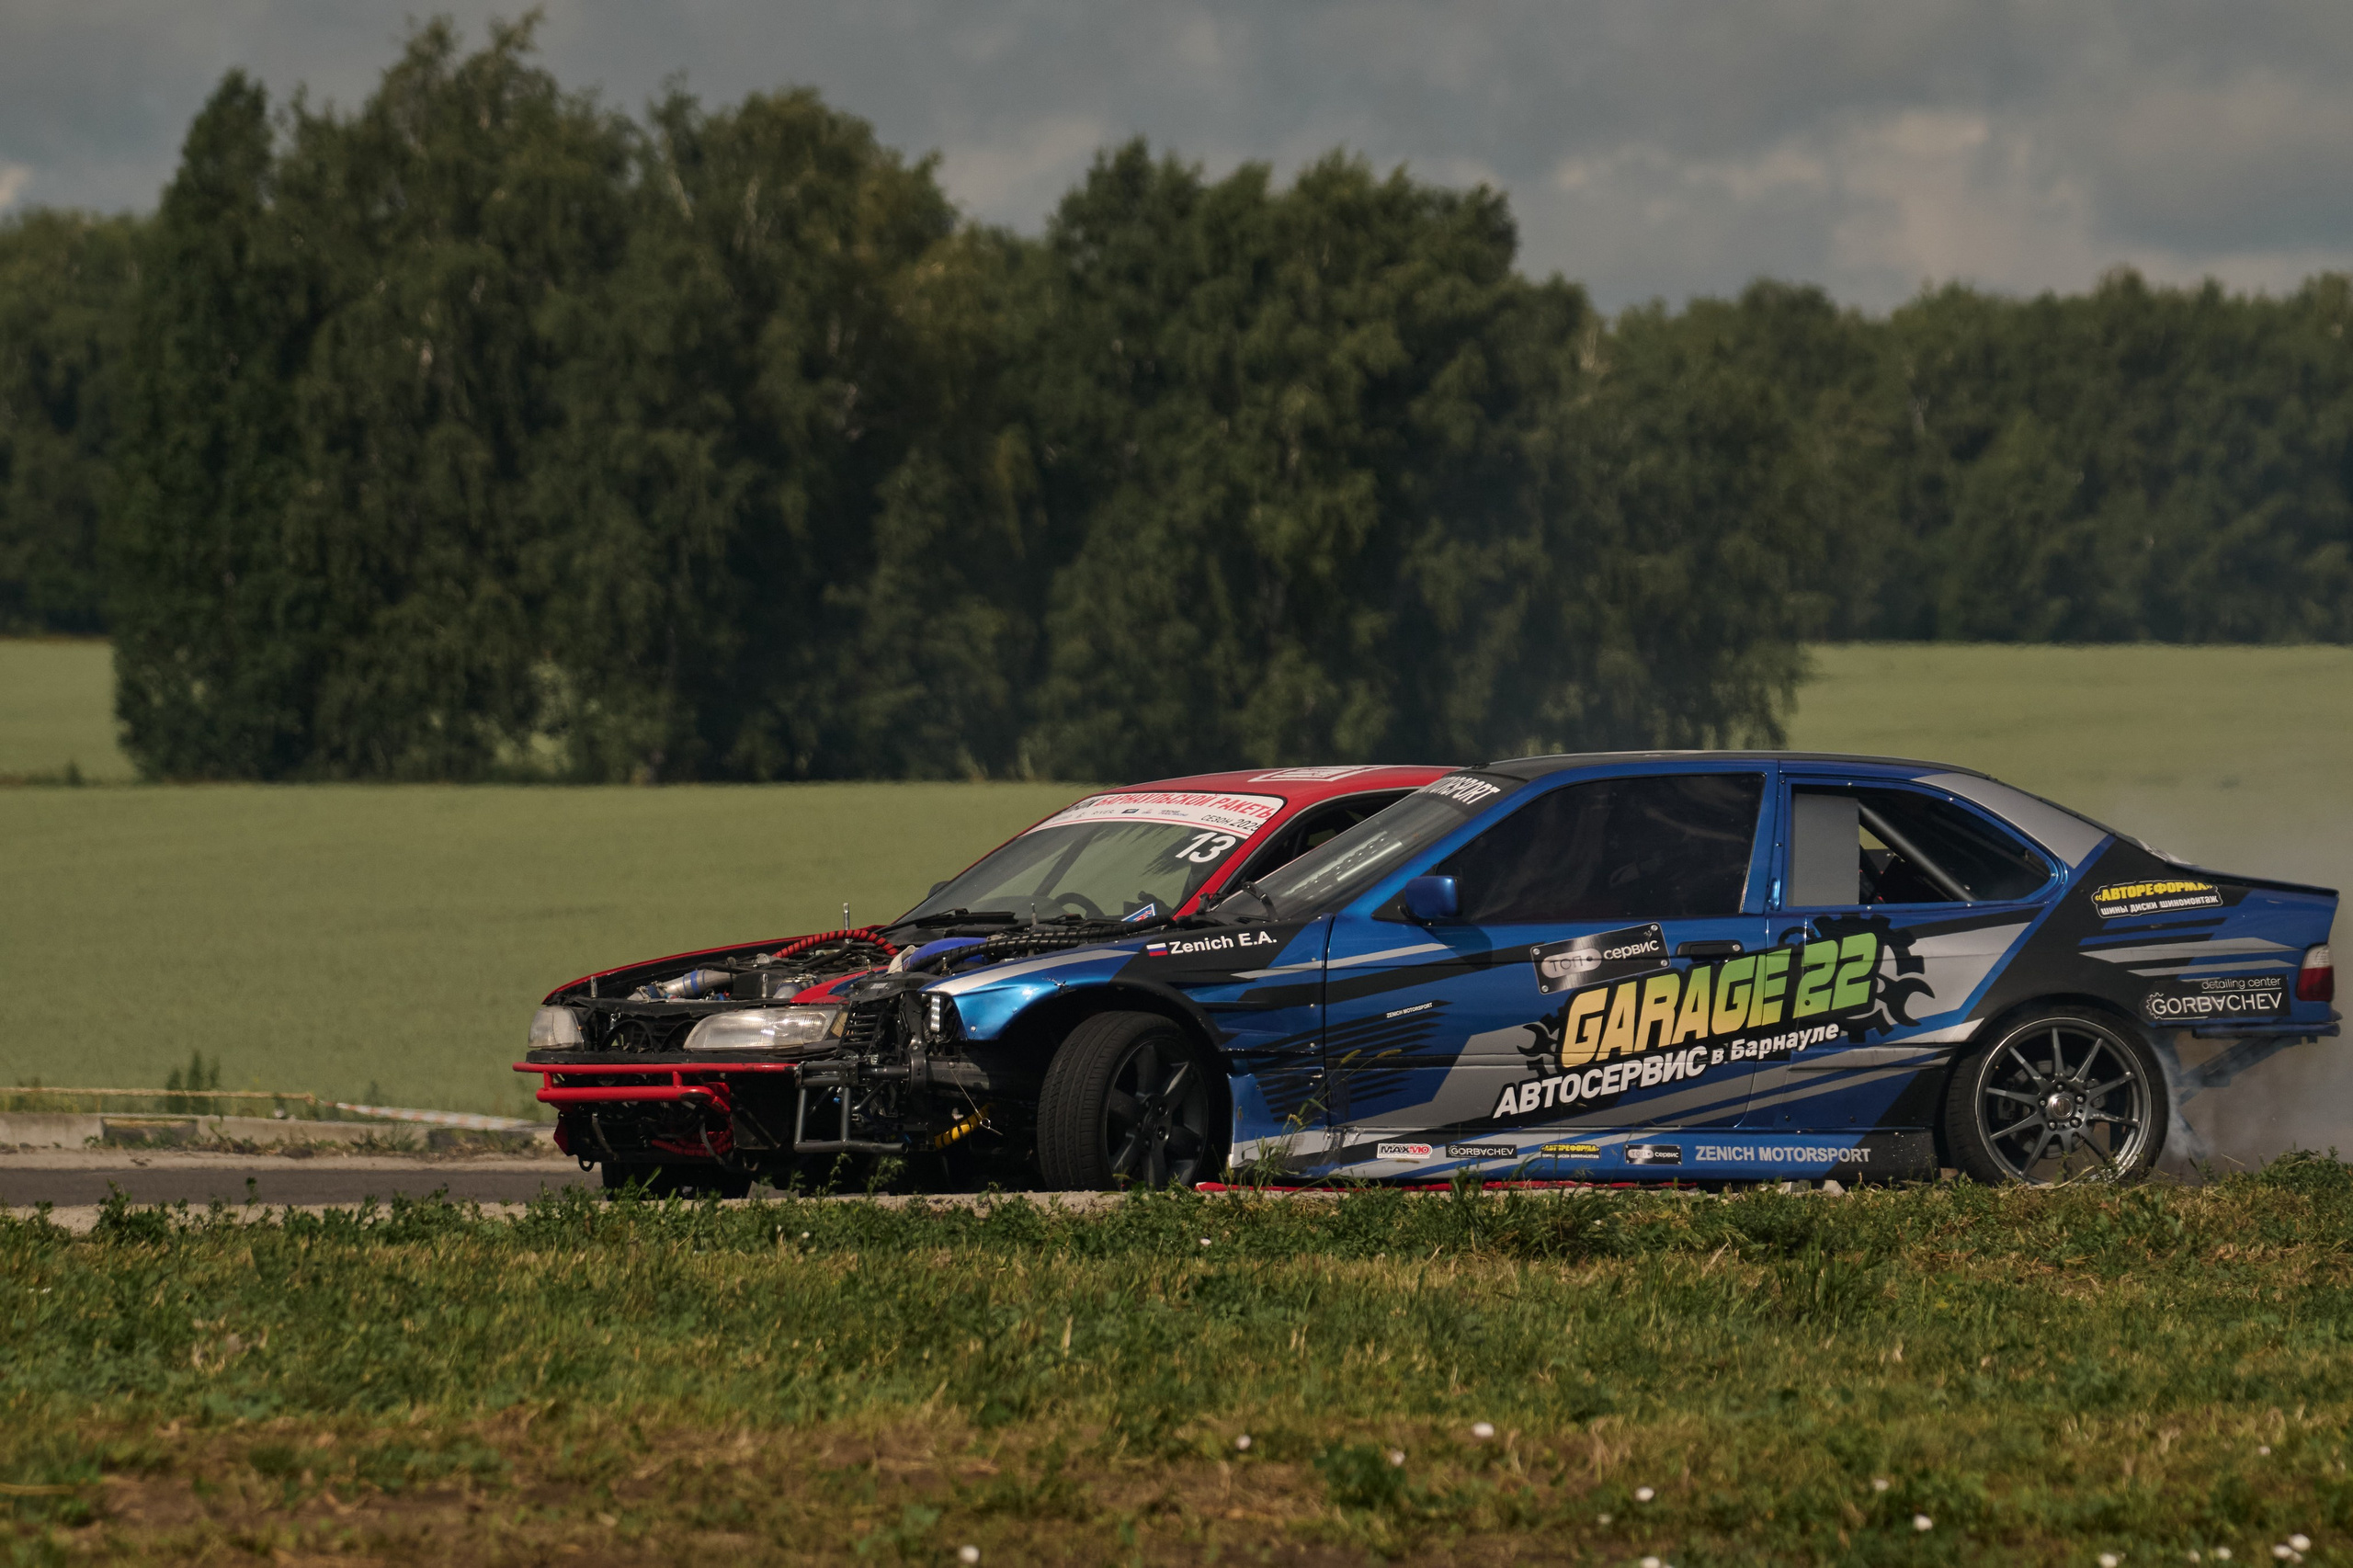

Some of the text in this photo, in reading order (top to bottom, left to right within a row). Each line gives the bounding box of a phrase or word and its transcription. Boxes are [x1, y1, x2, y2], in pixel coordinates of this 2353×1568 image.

[1094, 793, 1219, 807] БАРНАУЛЬСКОЙ
[1200, 814, 1232, 826] СЕЗОН
[1175, 831, 1236, 863] 13
[2095, 881, 2213, 902] «АВТОРЕФОРМА»
[1169, 930, 1278, 954] Zenich E.A.
[1549, 939, 1660, 972] ТОП сервис
[2201, 977, 2281, 990] detailing center
[1562, 932, 1878, 1068] GARAGE 22
[1493, 1023, 1839, 1119] АВТОСЕРВИС в Барнауле
[1654, 1151, 1679, 1159] сервис
[1695, 1145, 1871, 1163] ZENICH MOTORSPORT
